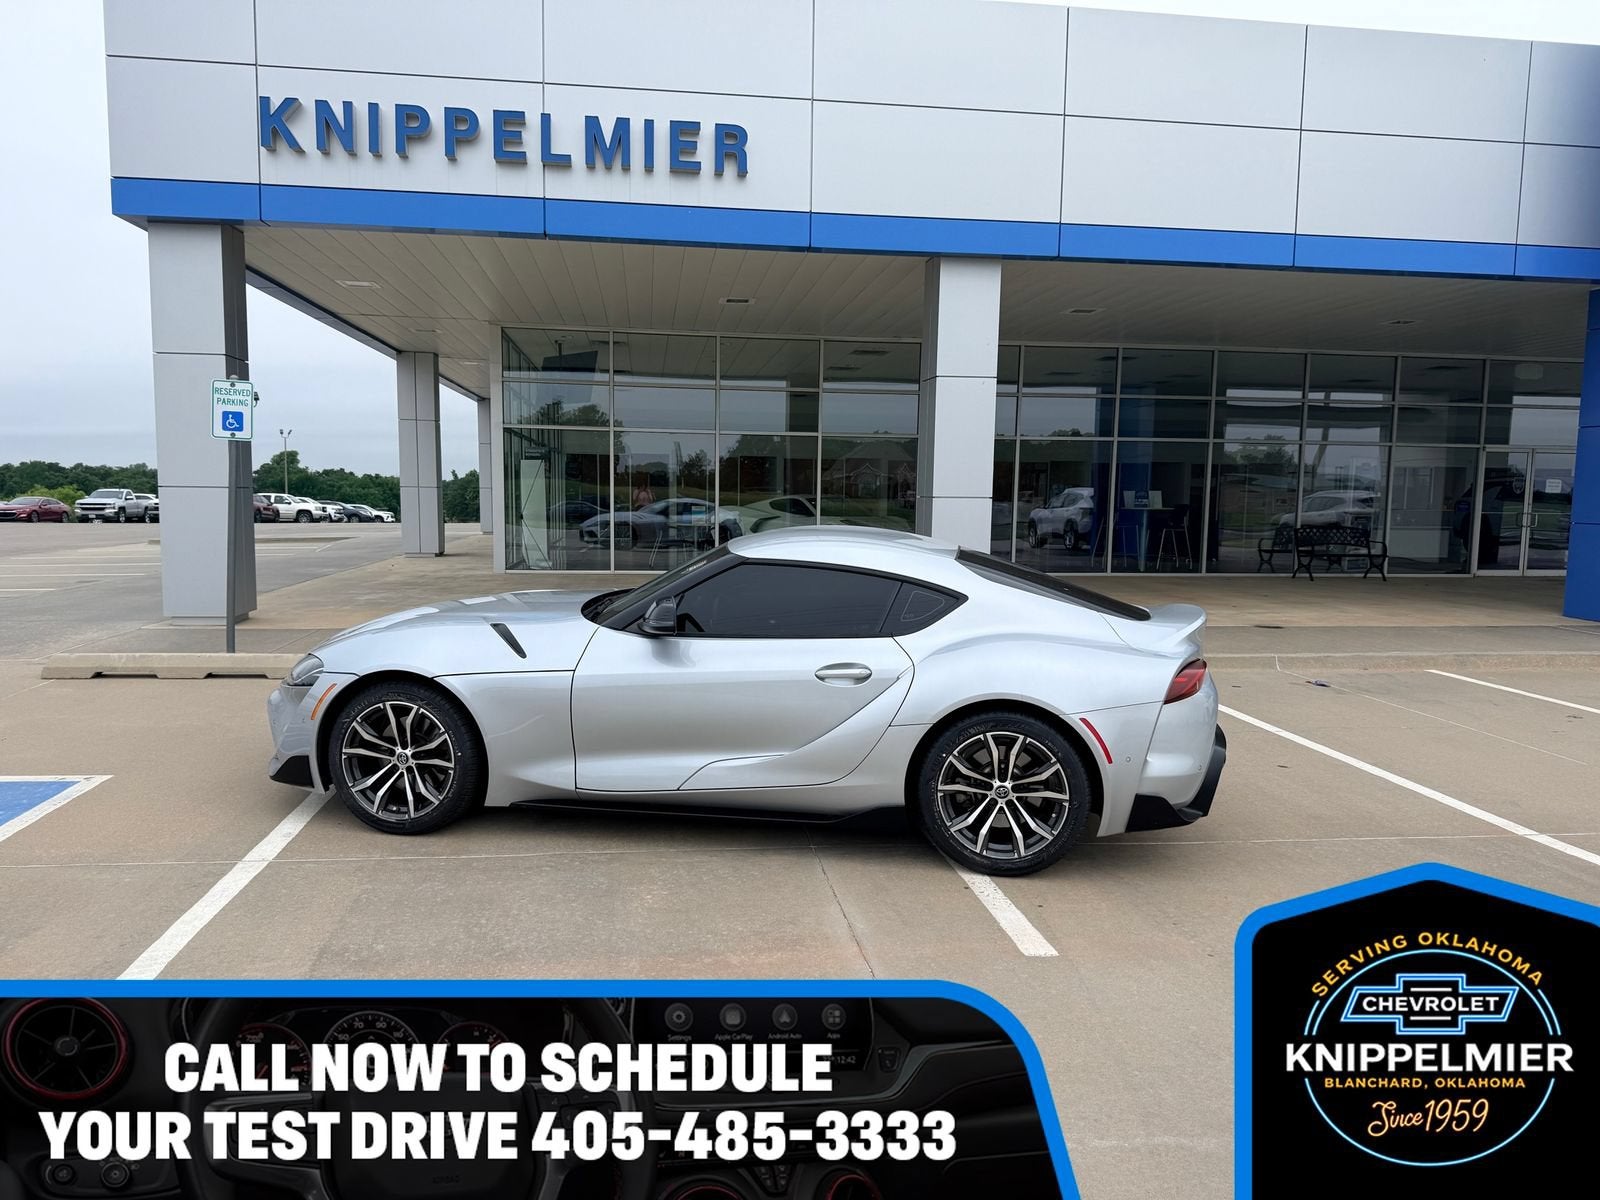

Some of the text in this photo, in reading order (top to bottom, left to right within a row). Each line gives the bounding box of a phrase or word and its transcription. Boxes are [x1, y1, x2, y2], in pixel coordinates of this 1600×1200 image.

[259, 96, 749, 177] KNIPPELMIER
[214, 387, 251, 396] RESERVED
[216, 398, 249, 407] PARKING
